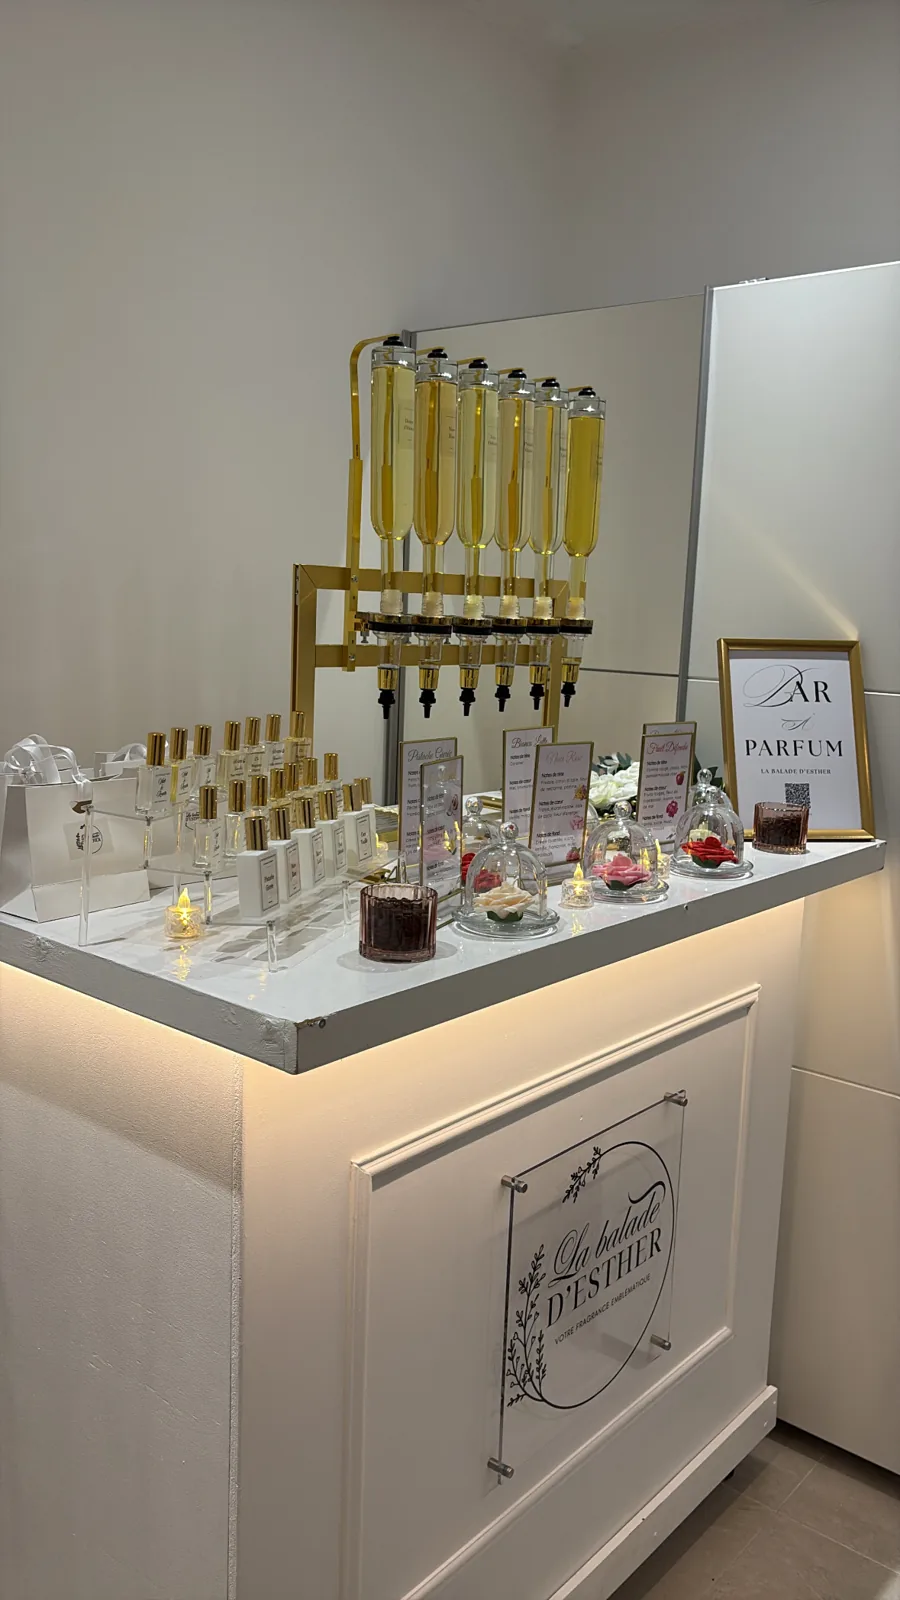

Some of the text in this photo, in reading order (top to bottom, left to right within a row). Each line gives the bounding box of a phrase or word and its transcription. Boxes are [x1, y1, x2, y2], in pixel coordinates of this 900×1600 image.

[745, 739, 843, 756] PARFUM
[548, 1181, 666, 1288] La balade
[547, 1227, 662, 1328] D'ESTHER
[554, 1326, 574, 1344] VOTRE
[575, 1302, 610, 1331] FRAGRANCE
